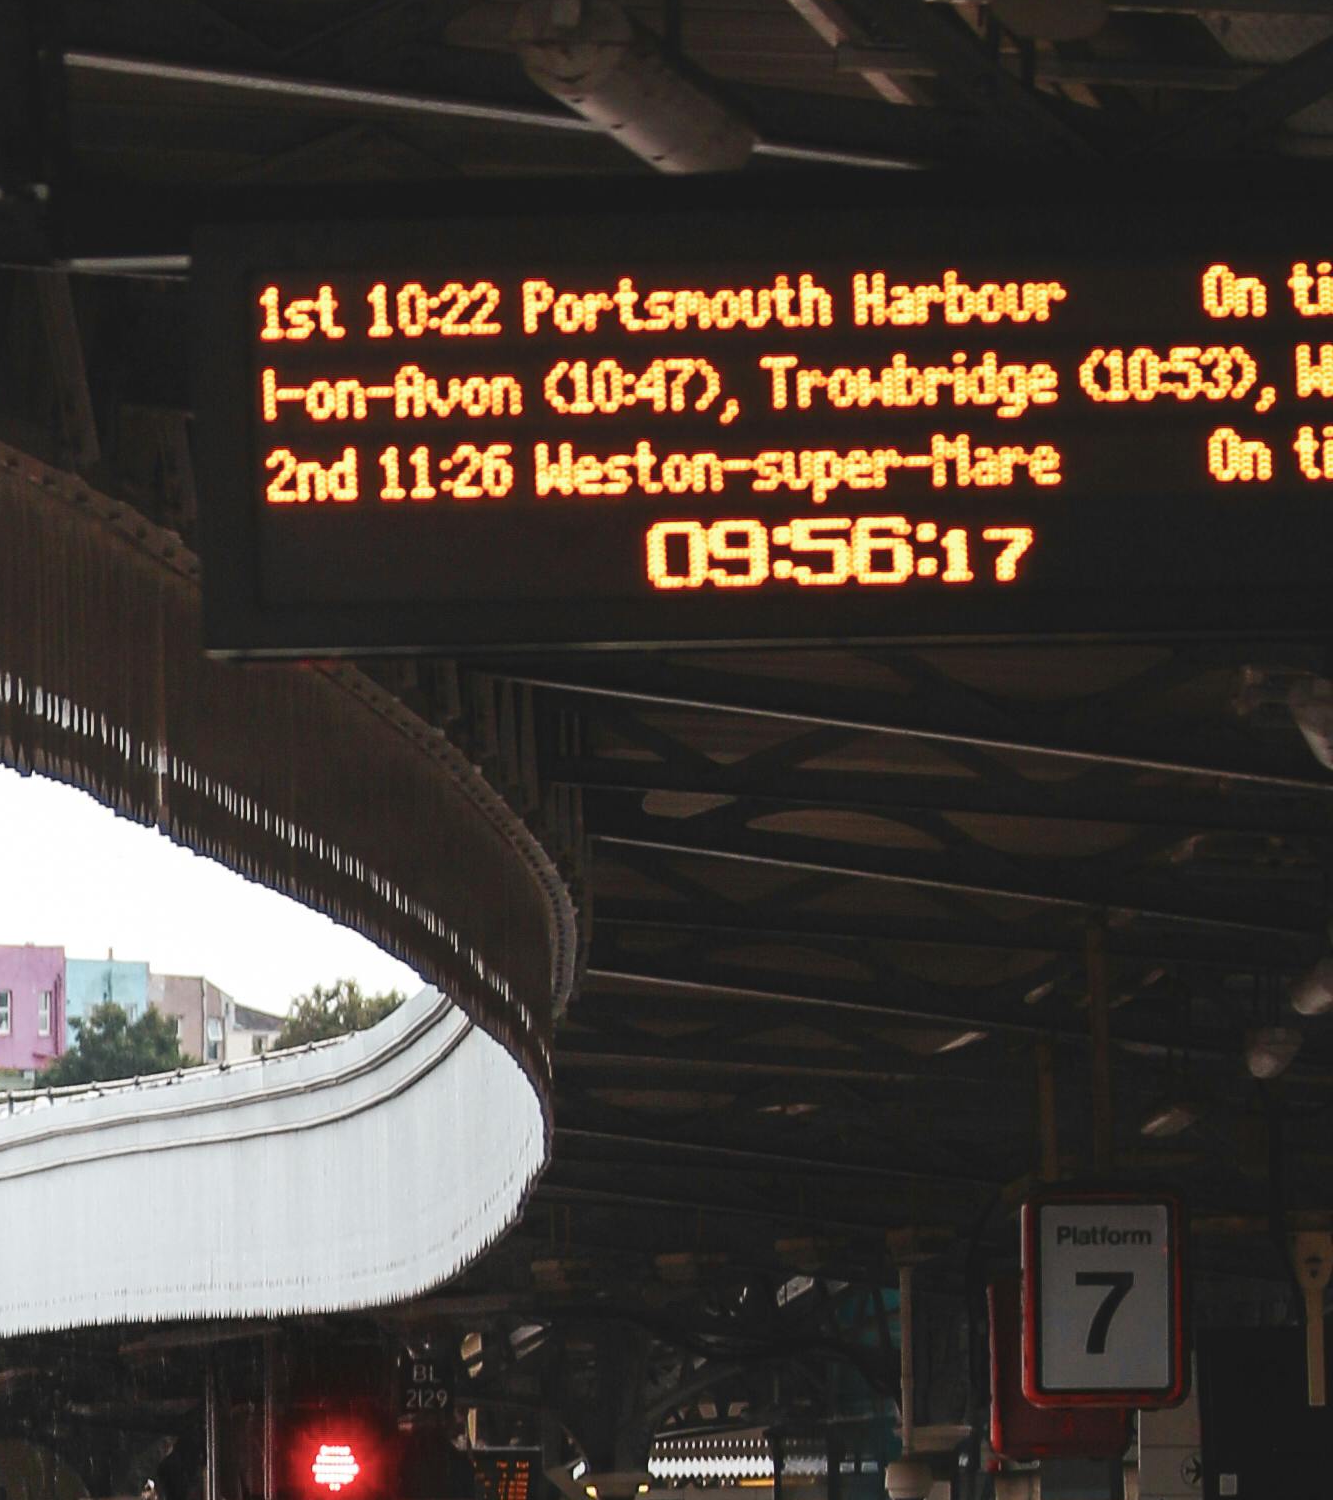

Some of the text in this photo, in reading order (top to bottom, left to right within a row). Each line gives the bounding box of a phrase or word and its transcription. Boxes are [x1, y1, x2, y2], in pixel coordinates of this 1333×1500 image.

[259, 270, 1067, 342] 1st 10:22 Portsmouth Harbour
[1202, 264, 1267, 318] On
[544, 358, 739, 424] (10:47),
[759, 350, 1058, 418] Trowbridge
[1078, 346, 1276, 413] (10:53),
[265, 434, 1061, 504] 2nd 11:26 Weston-super-Mare
[1208, 426, 1272, 482] On
[646, 516, 1034, 590] 09:56:17
[1057, 1226, 1152, 1245] Platform
[1076, 1272, 1134, 1354] 7
[406, 1390, 448, 1408] 2129
[413, 1365, 440, 1382] BL
